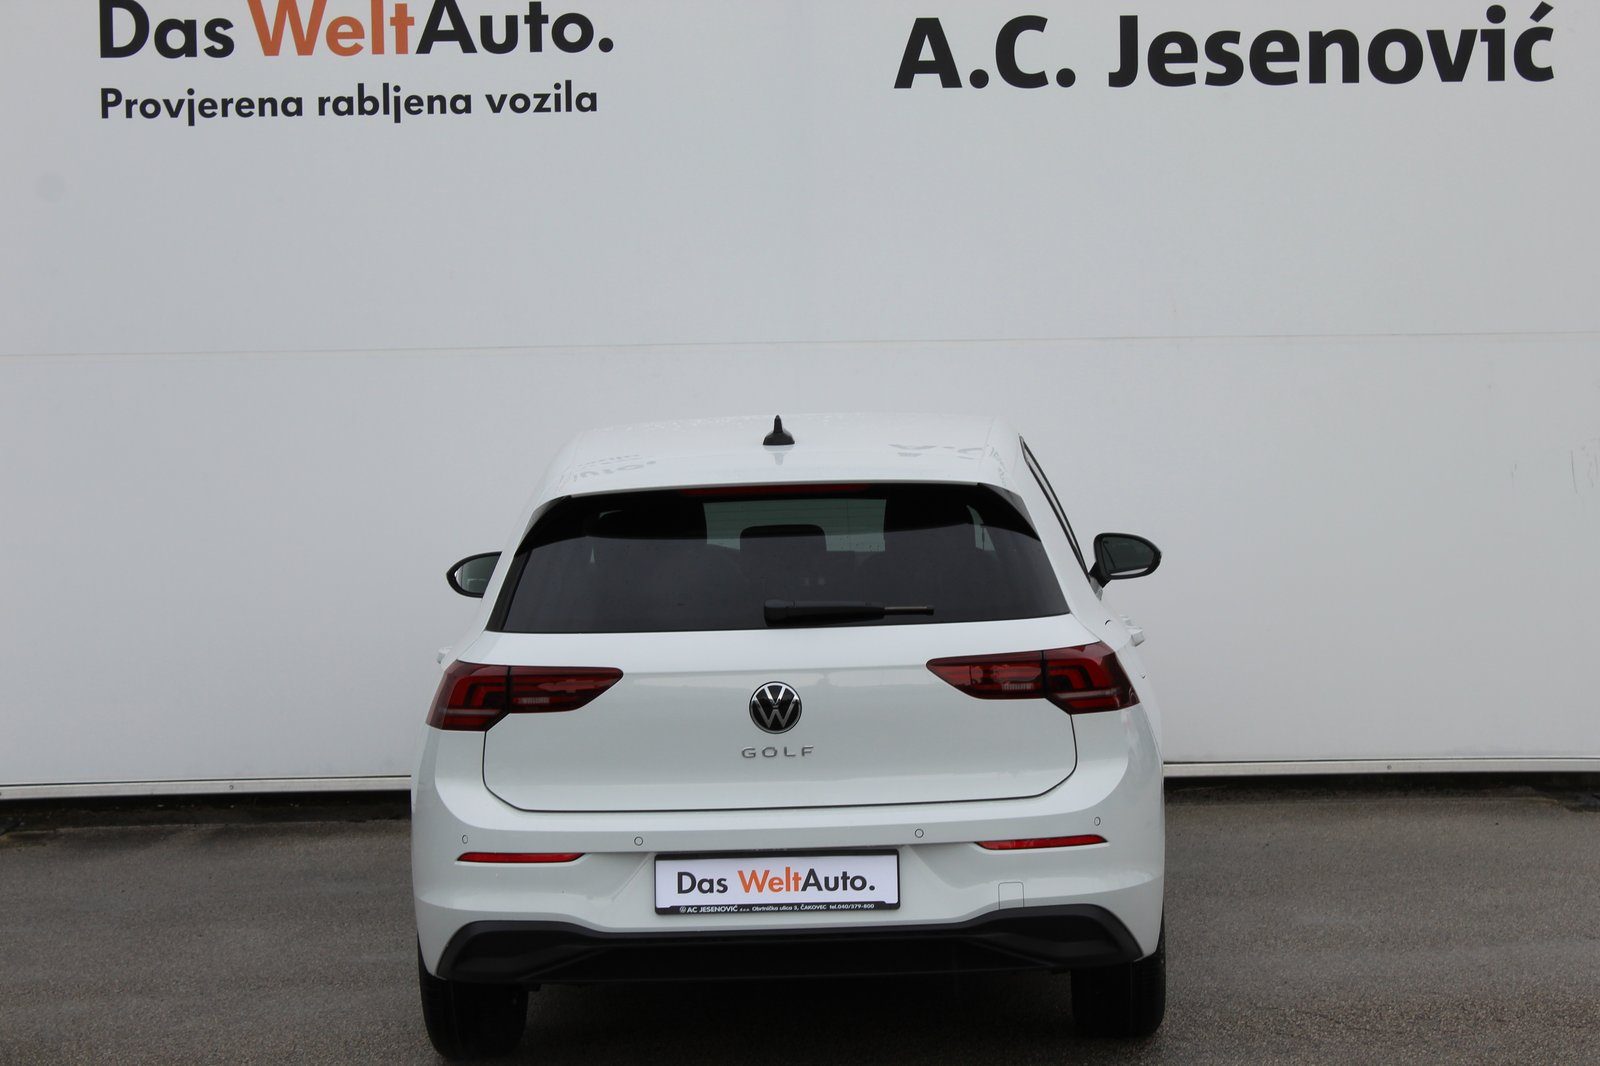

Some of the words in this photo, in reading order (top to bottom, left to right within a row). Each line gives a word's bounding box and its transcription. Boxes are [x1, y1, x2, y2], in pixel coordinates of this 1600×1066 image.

[98, 0, 235, 59] Das
[247, 0, 614, 57] WeltAuto.
[893, 14, 1076, 89] A.C.
[1108, 0, 1555, 88] Jesenović
[100, 87, 303, 127] Provjerena
[317, 82, 472, 124] rabljena
[484, 79, 598, 114] vozila
[740, 745, 815, 759] GOLF
[677, 871, 729, 895] Das
[737, 866, 876, 894] WeltAuto.
[699, 904, 738, 913] JESENOVIĆ
